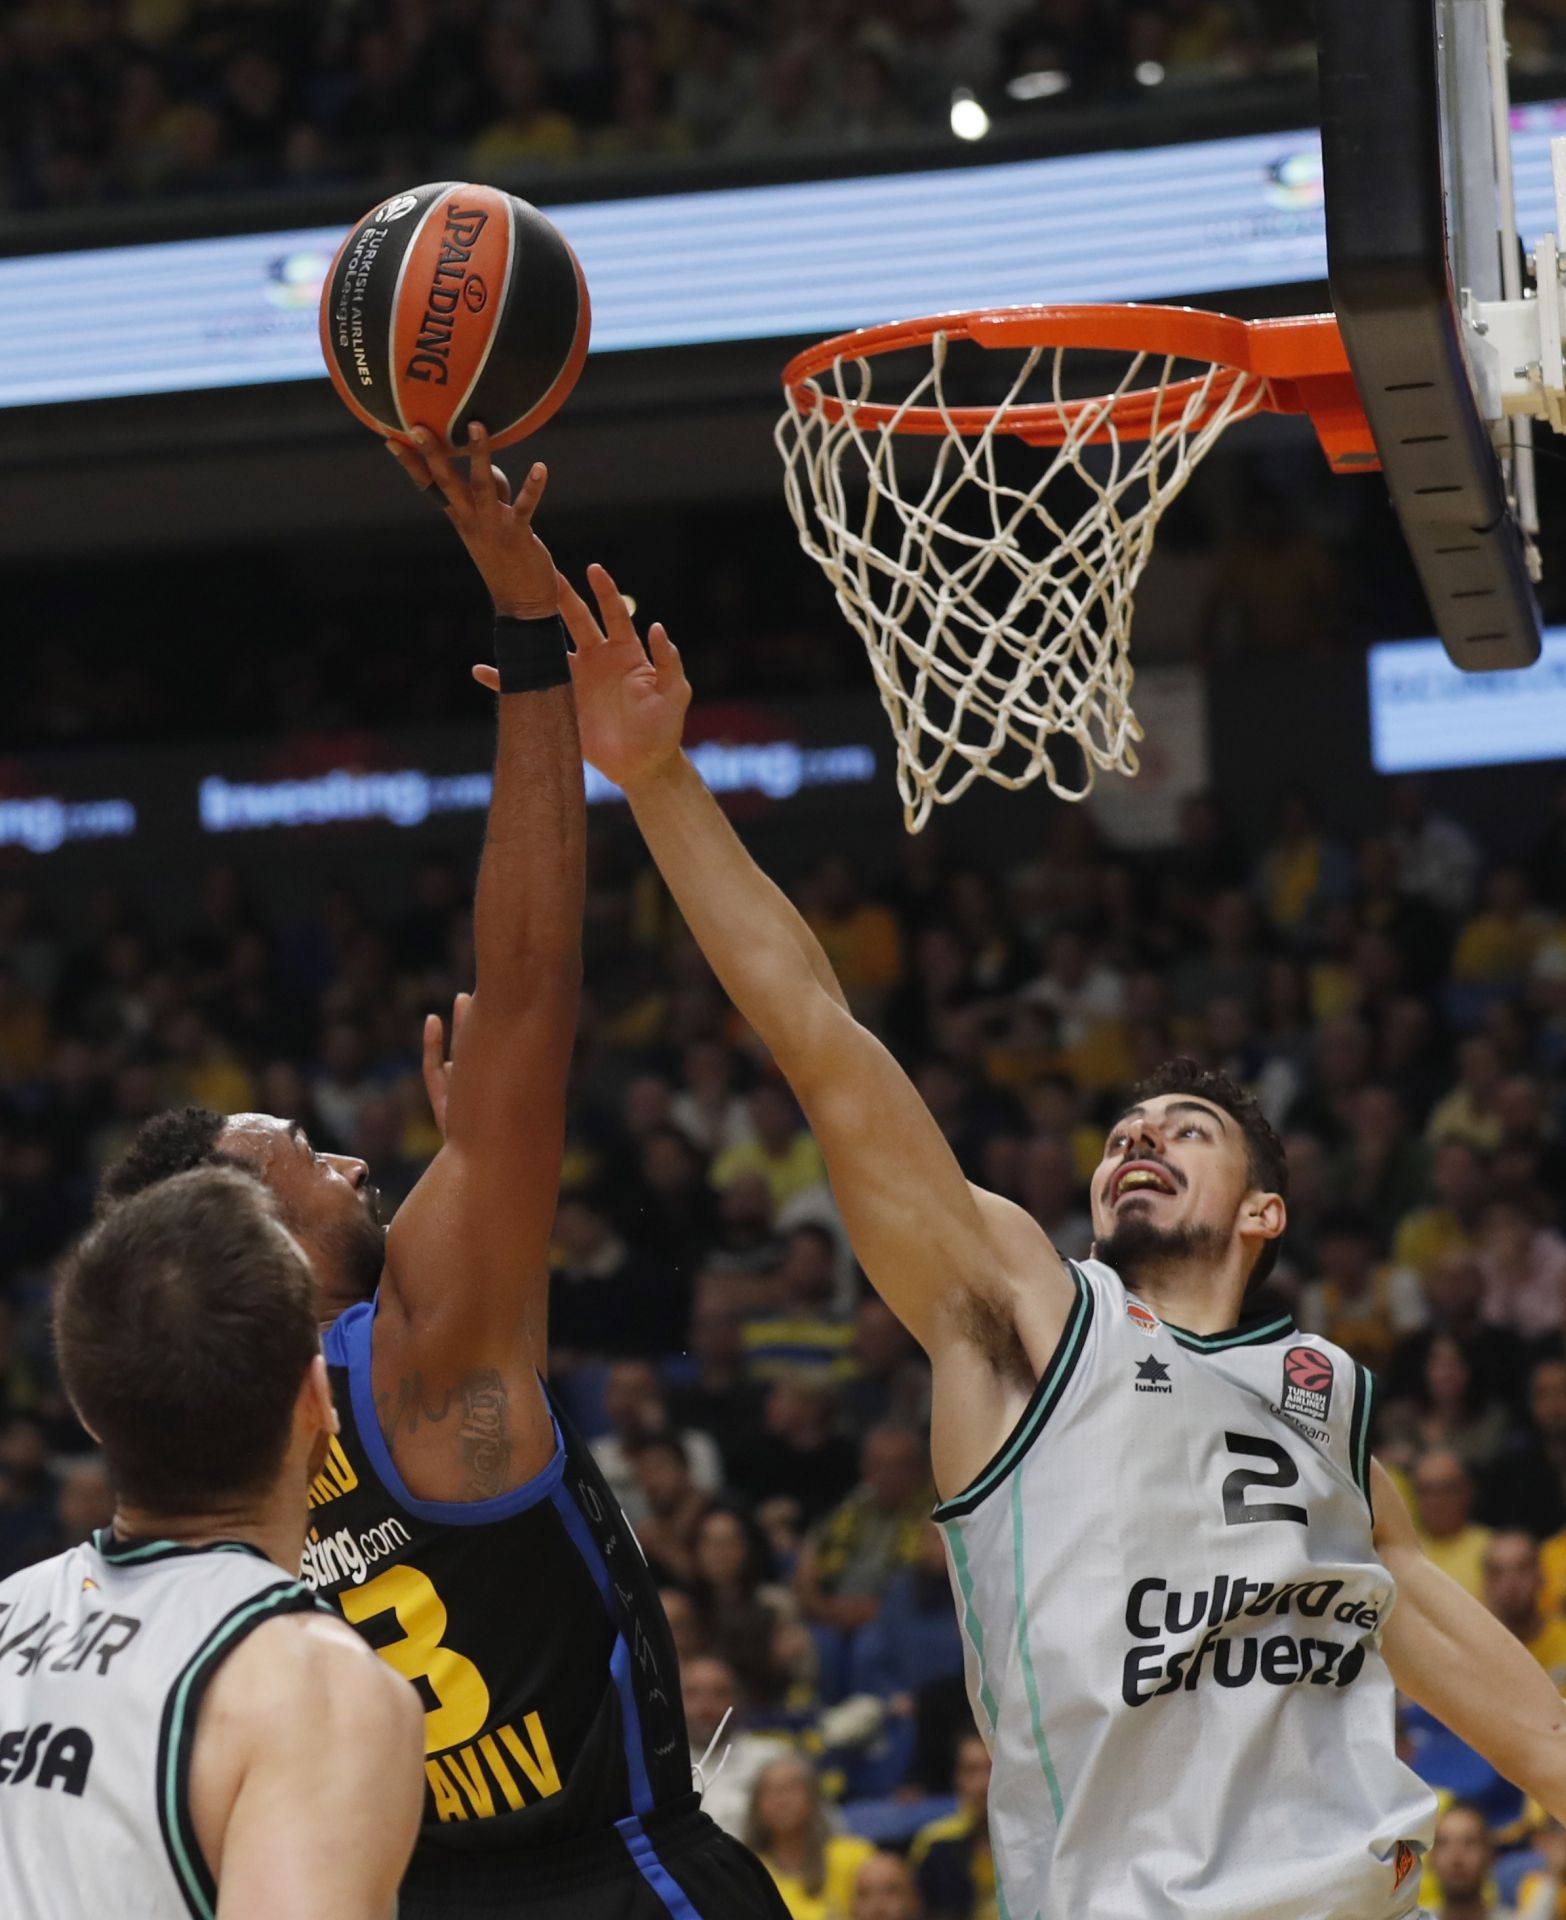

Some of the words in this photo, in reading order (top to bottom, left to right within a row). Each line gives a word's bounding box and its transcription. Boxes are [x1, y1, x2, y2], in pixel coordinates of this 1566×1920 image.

[351, 228, 388, 302] TURKISH
[405, 204, 488, 386] SPALDING
[351, 307, 373, 386] AIRLINES
[1135, 1382, 1173, 1394] luanvi
[1285, 1394, 1326, 1412] AIRLINES
[1287, 1386, 1327, 1404] TURKISH
[1222, 1431, 1308, 1526] 2
[1125, 1575, 1345, 1639] Cultura
[1122, 1627, 1366, 1707] Esfuerzo
[424, 1710, 563, 1824] AVIV
